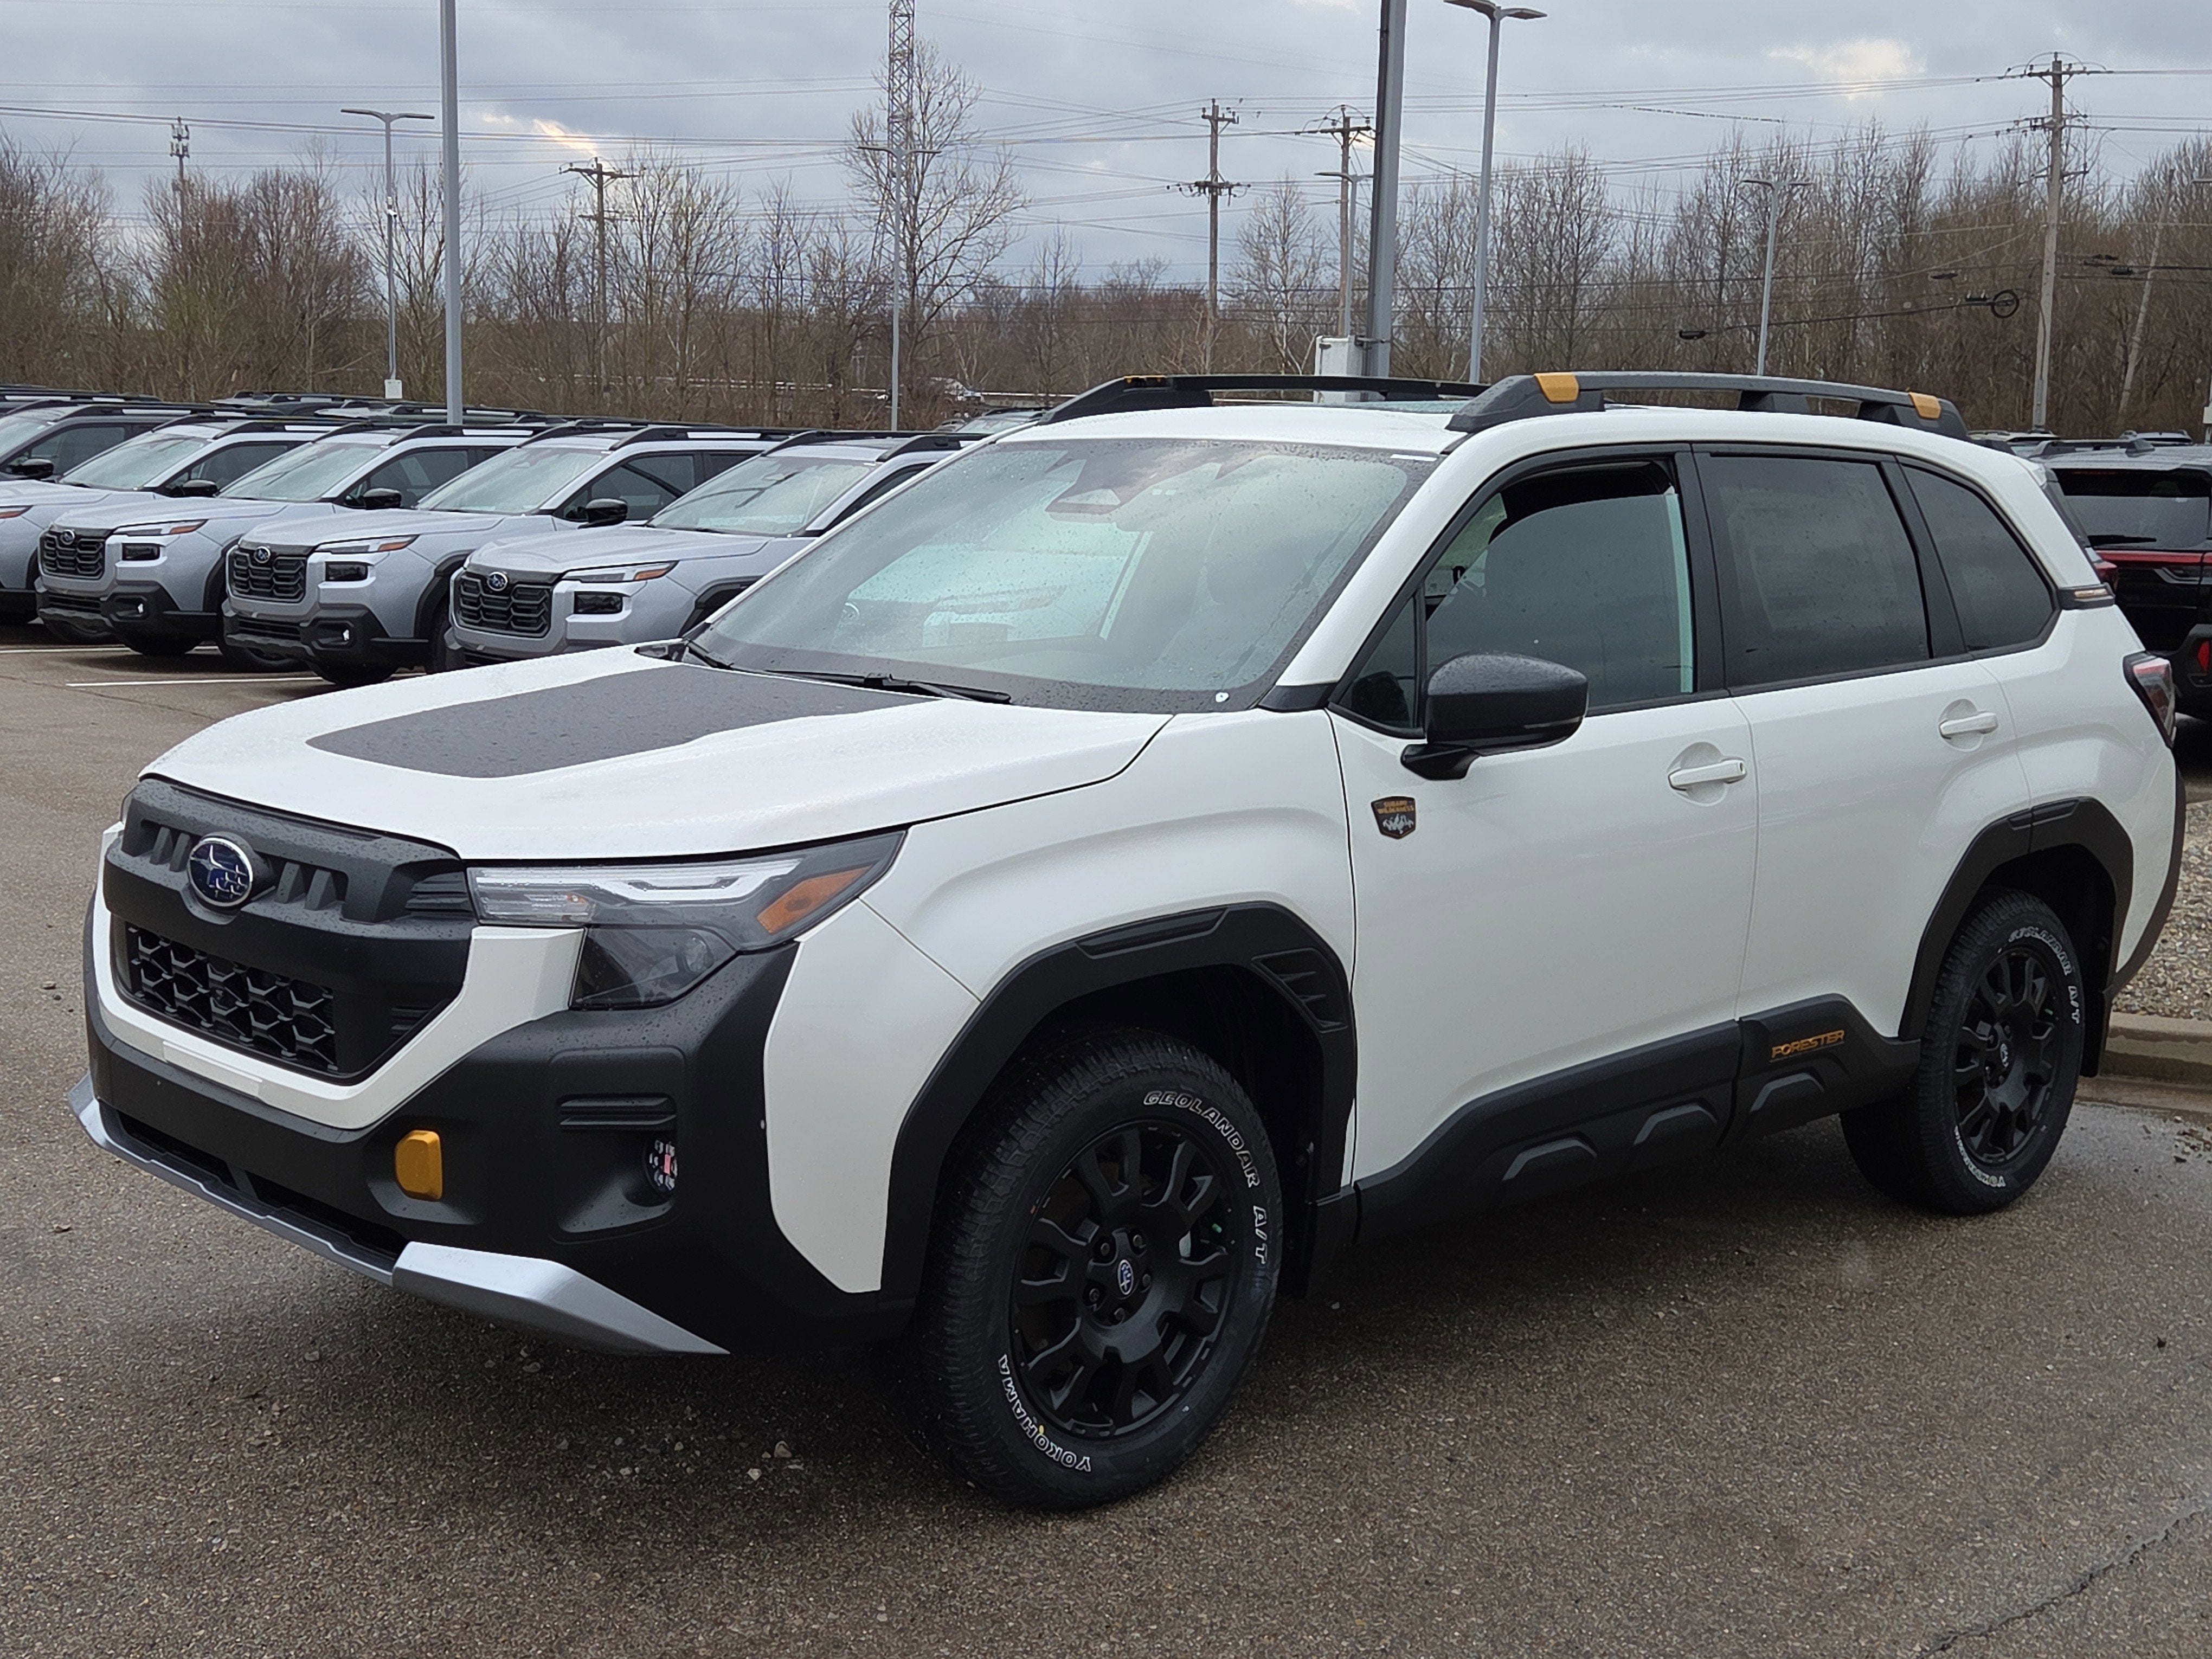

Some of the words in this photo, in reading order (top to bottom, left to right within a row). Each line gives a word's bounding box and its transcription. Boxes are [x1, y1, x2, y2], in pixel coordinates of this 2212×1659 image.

[1771, 1030, 1844, 1058] FORESTER
[1143, 1090, 1261, 1188] GEOLANDAR
[1253, 1205, 1268, 1264] A/T
[998, 1354, 1091, 1472] YOKOHAMA
